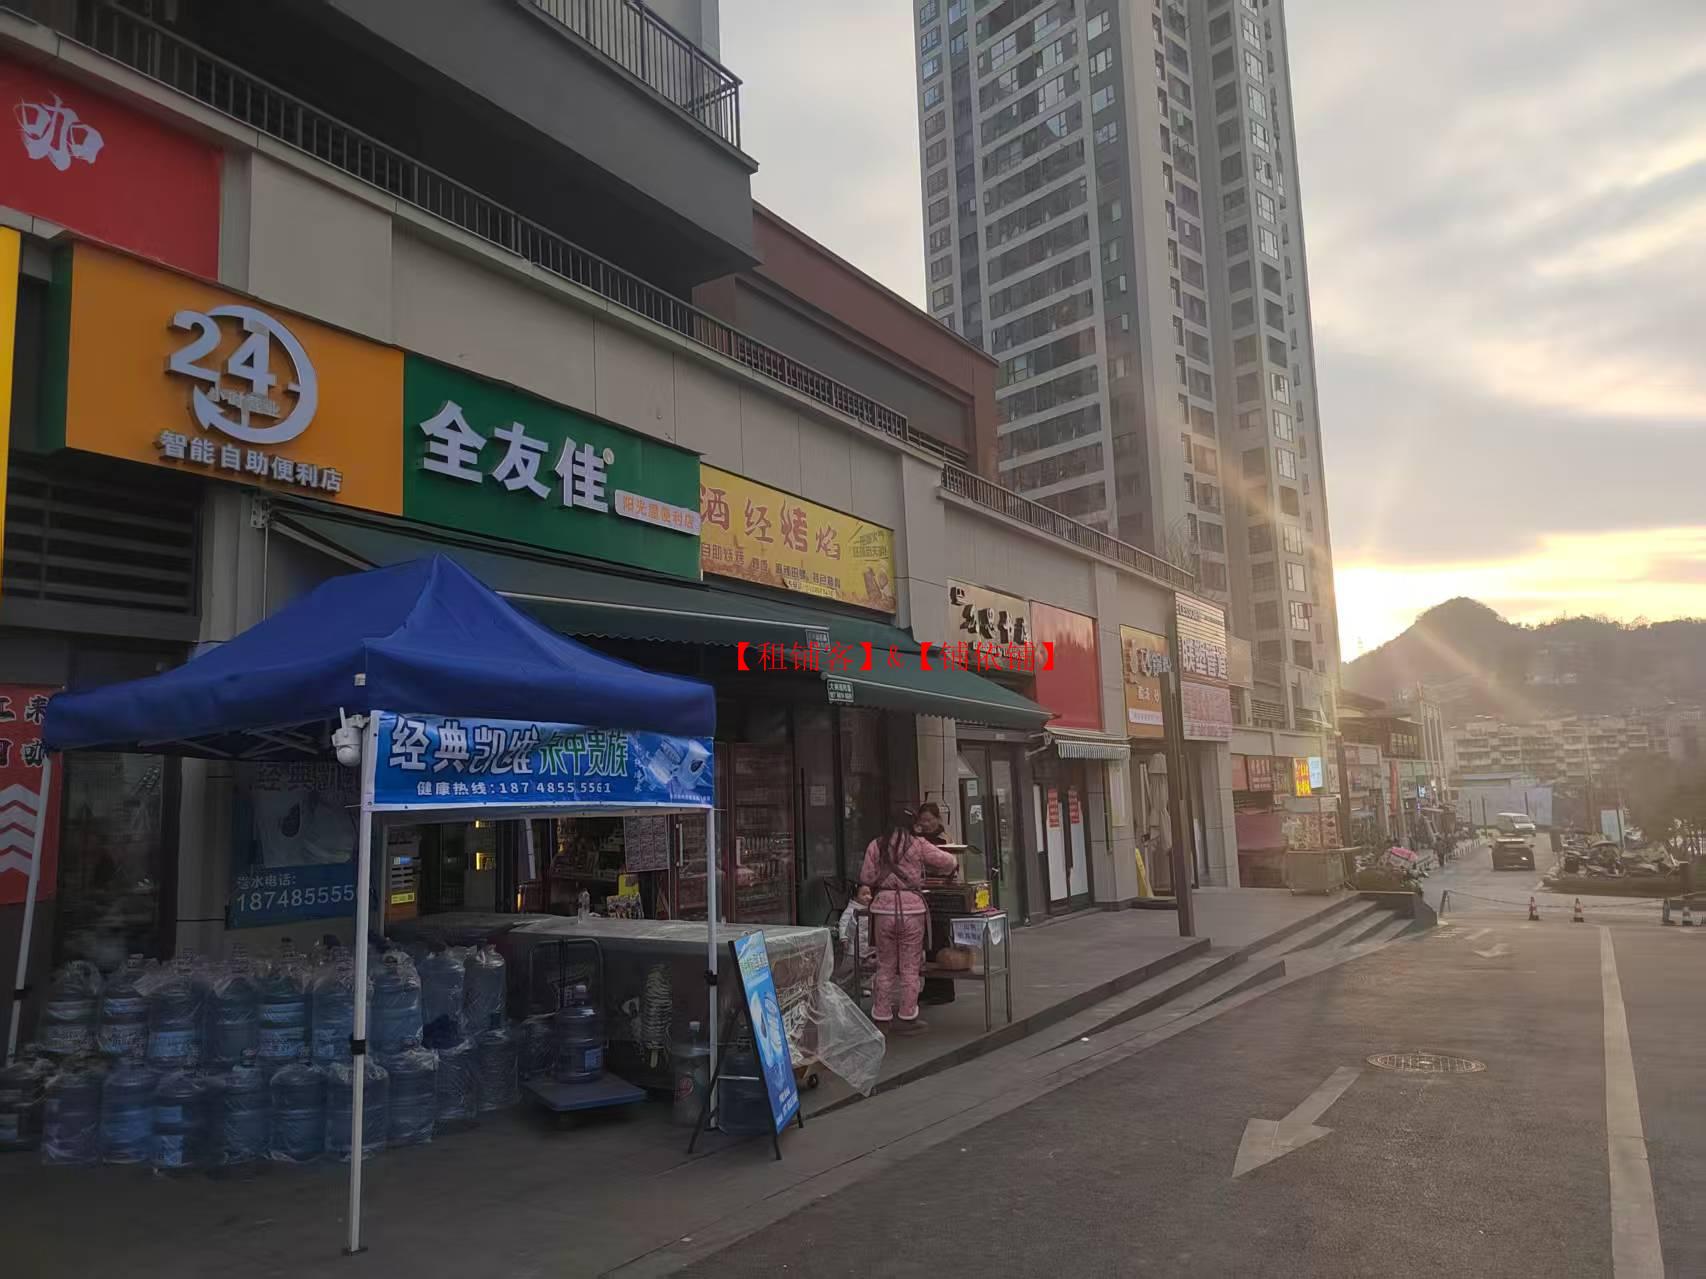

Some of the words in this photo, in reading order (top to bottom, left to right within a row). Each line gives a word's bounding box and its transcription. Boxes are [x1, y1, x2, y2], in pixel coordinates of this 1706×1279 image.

[14, 92, 104, 171] 咖
[160, 430, 344, 493] 智能自助便利店
[419, 400, 609, 513] 全友佳
